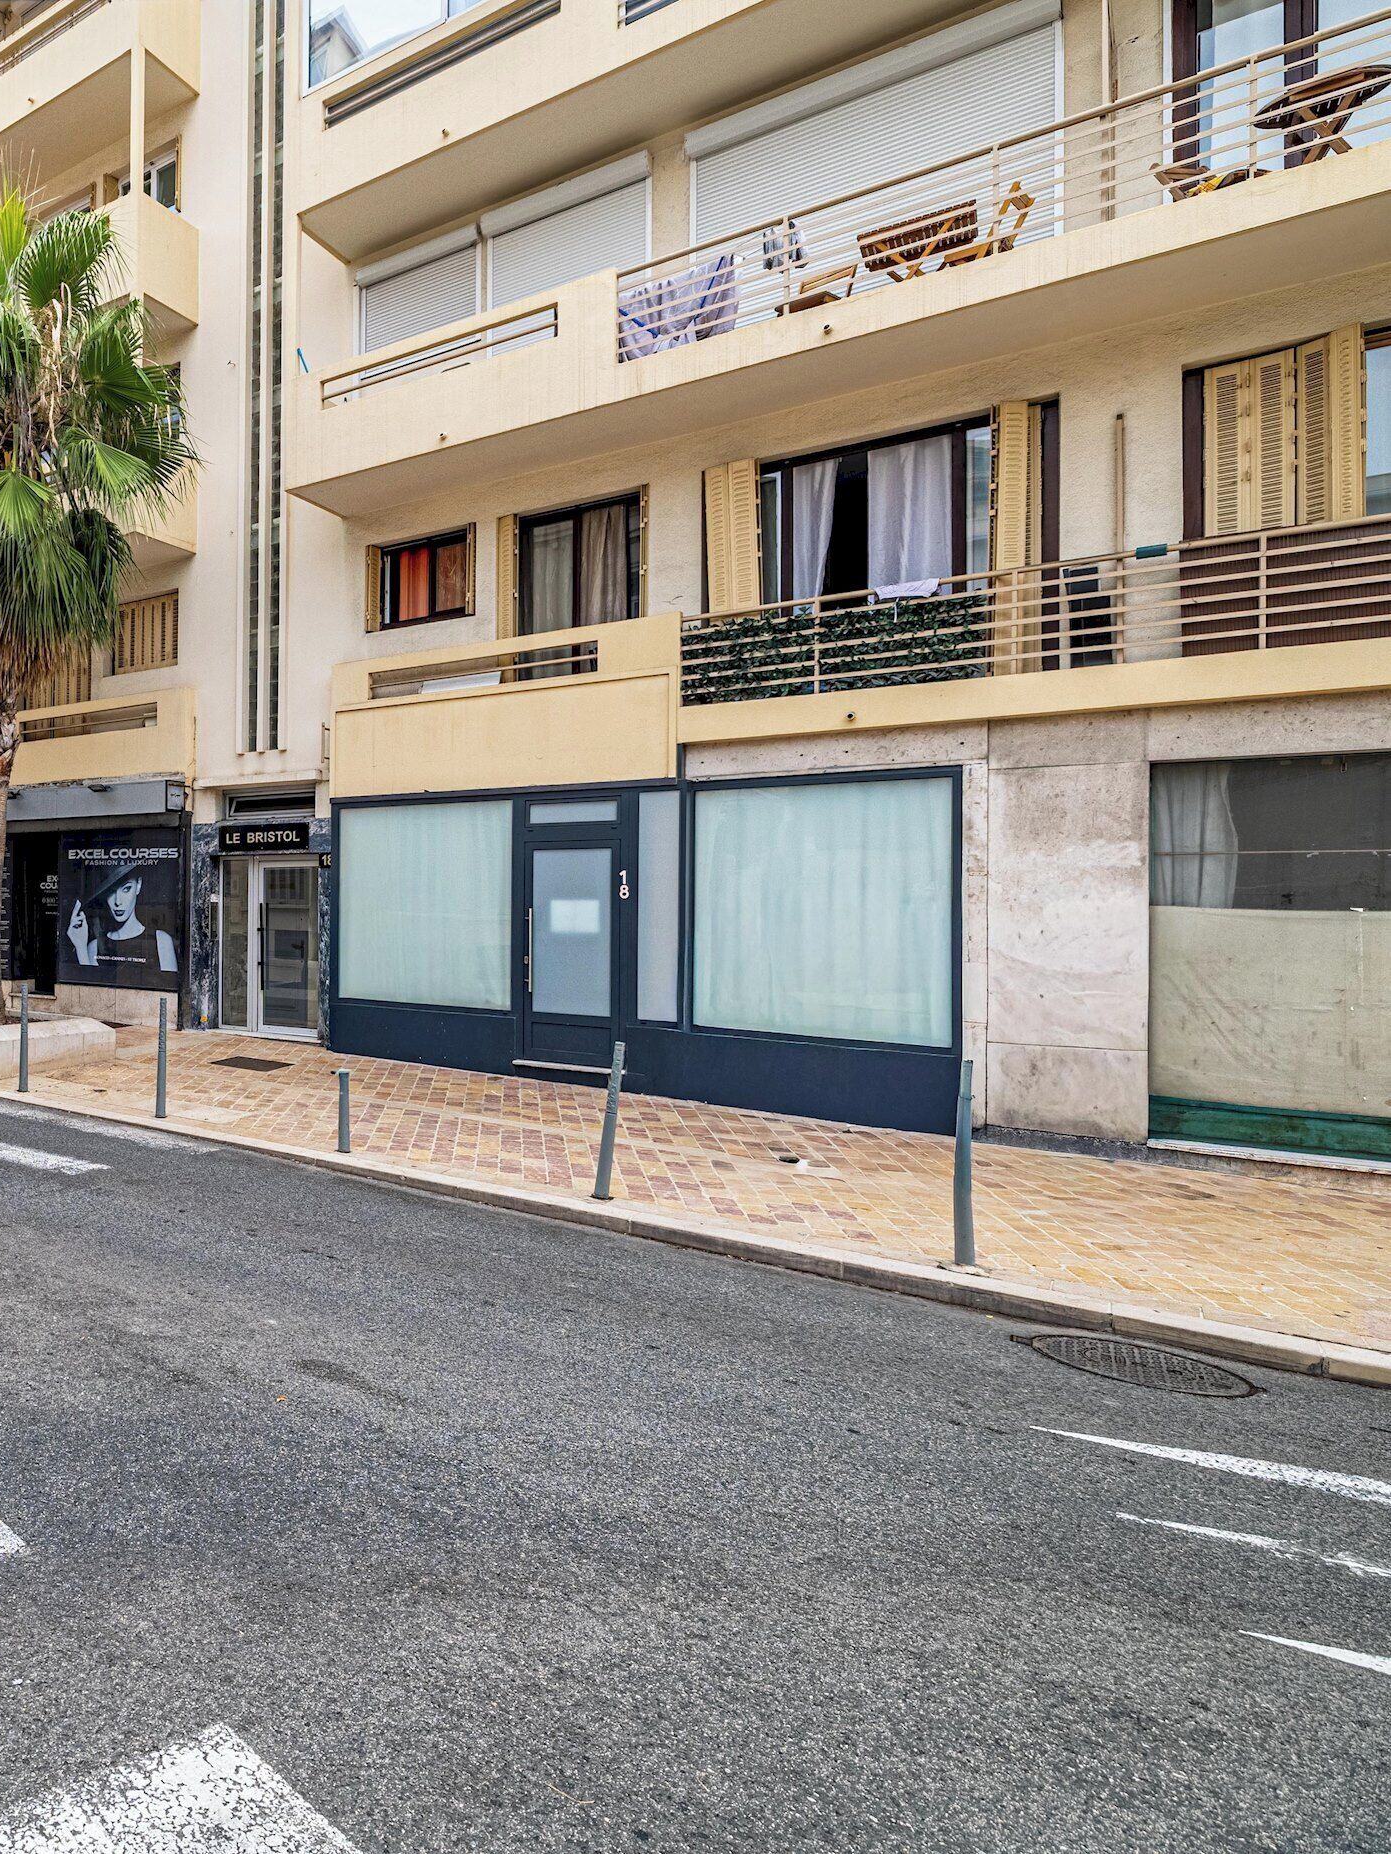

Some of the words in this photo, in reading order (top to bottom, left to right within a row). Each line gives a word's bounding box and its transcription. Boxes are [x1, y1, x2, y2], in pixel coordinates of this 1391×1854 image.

[226, 833, 241, 844] LE
[246, 830, 300, 843] BRISTOL
[68, 849, 109, 859] EXCEL
[110, 848, 179, 859] COURSES
[619, 870, 630, 899] 18
